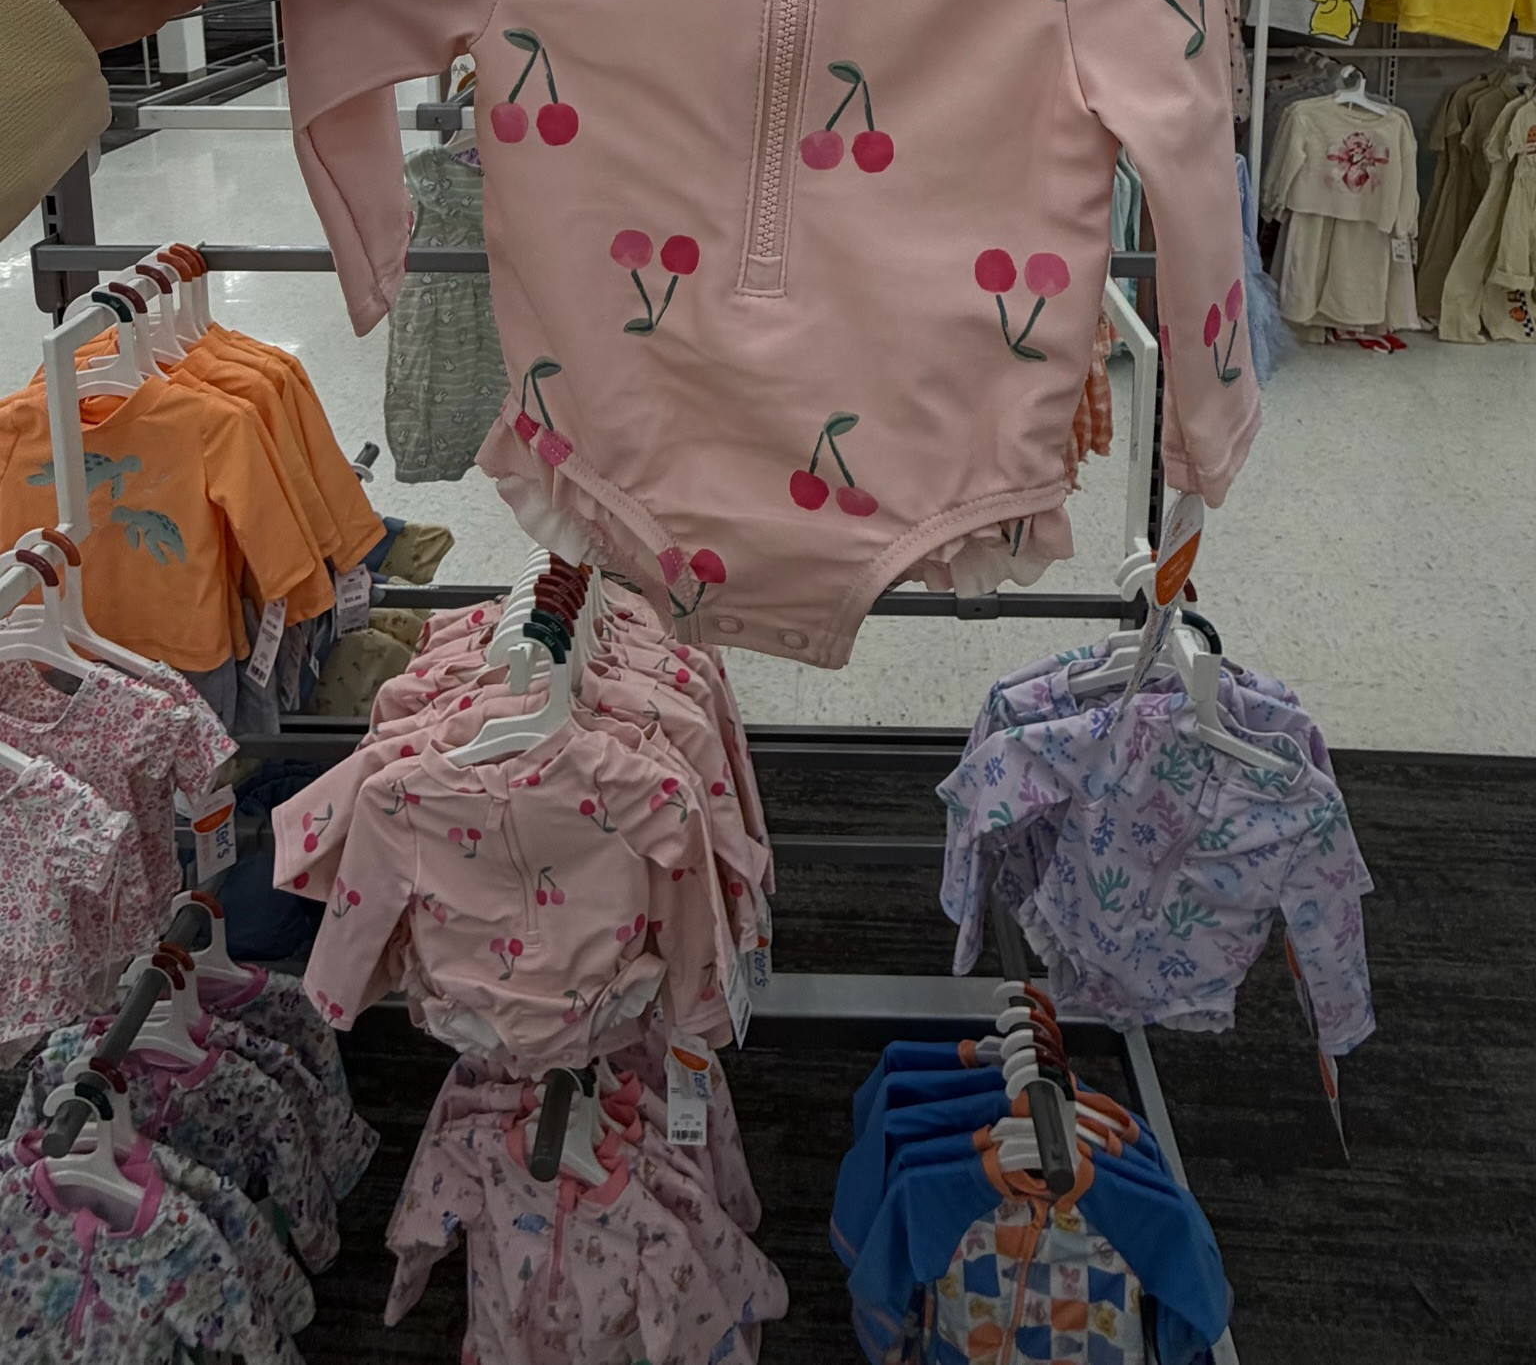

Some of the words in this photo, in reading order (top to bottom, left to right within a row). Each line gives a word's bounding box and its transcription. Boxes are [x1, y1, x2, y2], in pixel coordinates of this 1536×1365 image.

[215, 822, 235, 860] ter's
[754, 949, 770, 988] ter's
[693, 1072, 712, 1100] ter's
